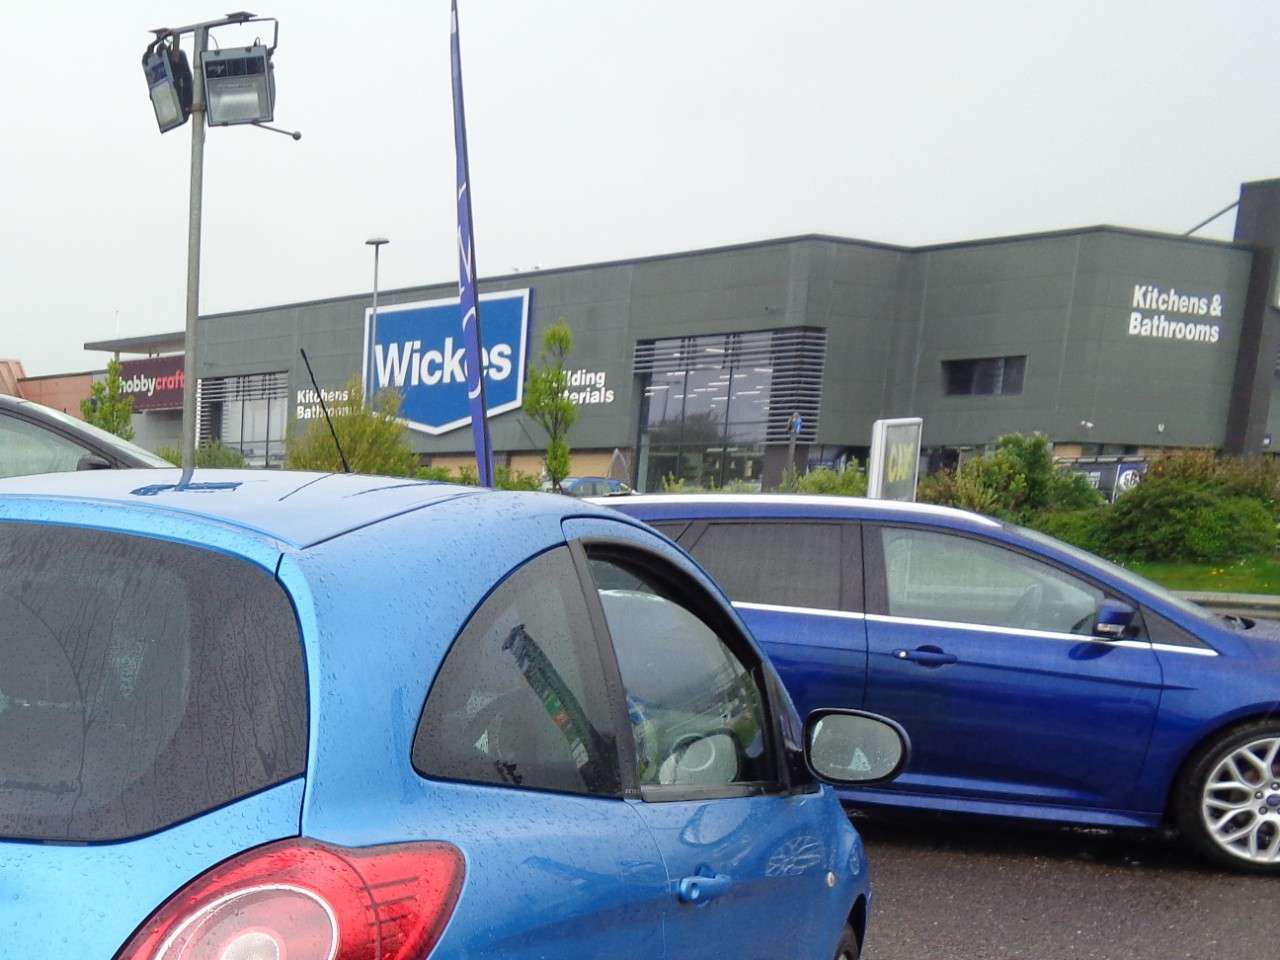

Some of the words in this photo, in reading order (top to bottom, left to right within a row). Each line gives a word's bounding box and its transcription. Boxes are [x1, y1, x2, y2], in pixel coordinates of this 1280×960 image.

[1132, 284, 1207, 315] Kitchens
[1210, 293, 1223, 317] &
[1128, 311, 1220, 343] Bathrooms
[119, 369, 185, 396] hobbycraft
[297, 388, 349, 404] Kitchens
